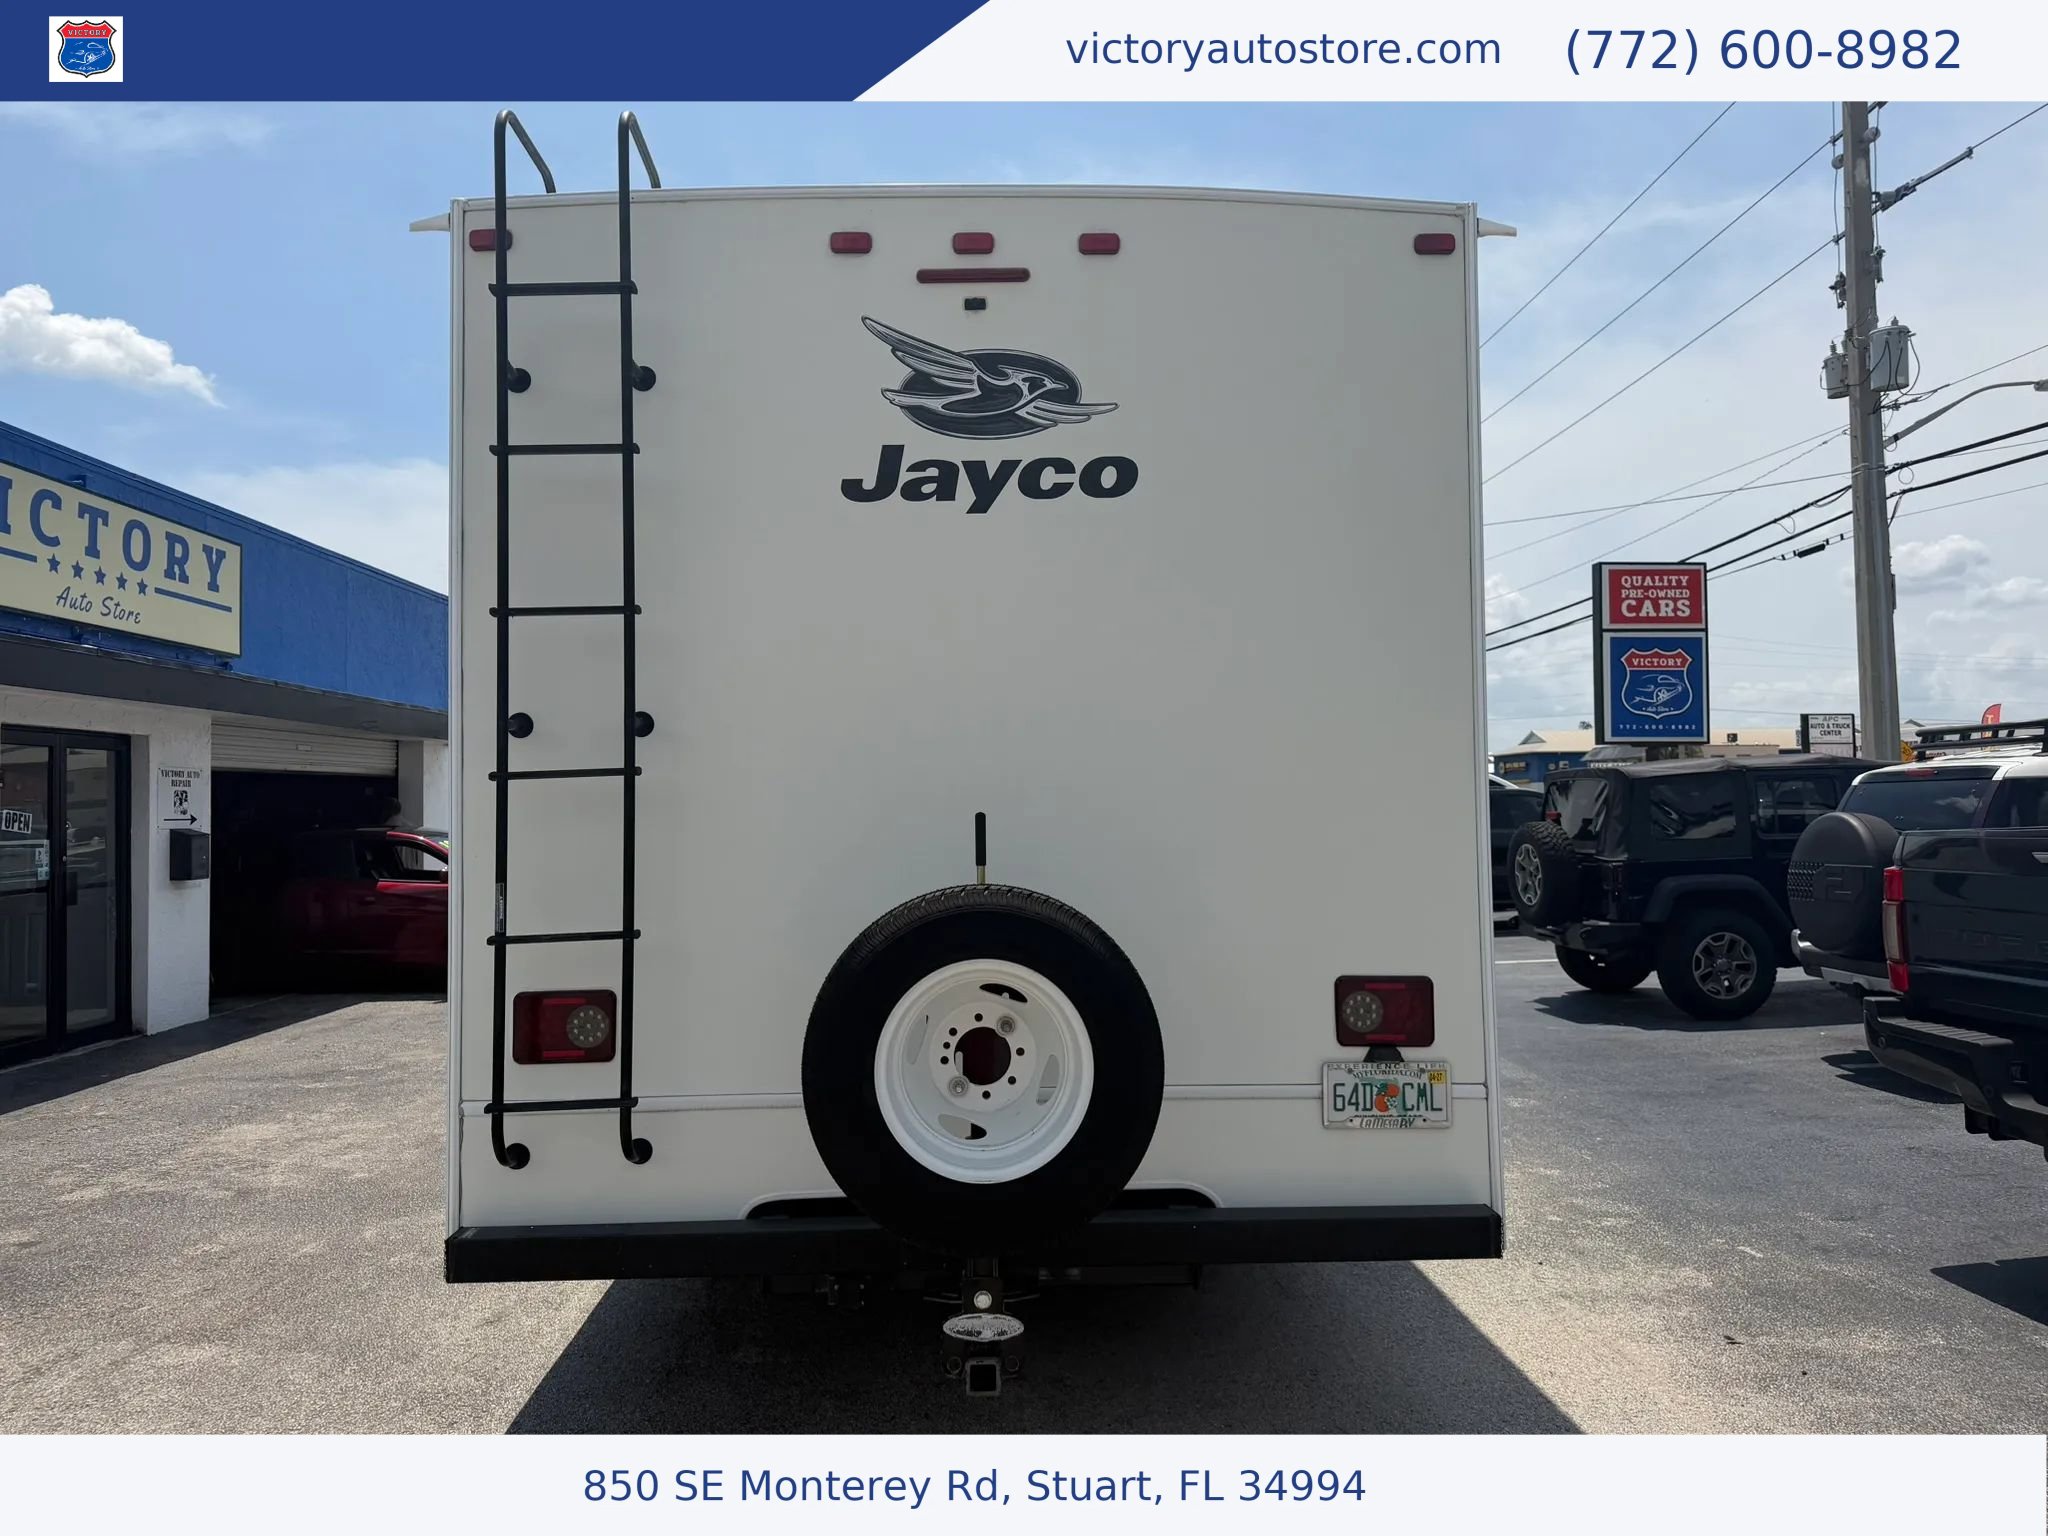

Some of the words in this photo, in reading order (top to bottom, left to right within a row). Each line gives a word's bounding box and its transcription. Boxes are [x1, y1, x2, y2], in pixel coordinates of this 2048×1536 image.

[841, 444, 1139, 514] Jayco
[1620, 575, 1689, 588] QUALITY
[1620, 589, 1690, 599] PRE-OWNED
[56, 585, 93, 613] Auto
[100, 596, 141, 625] Store
[1621, 600, 1691, 617] CARS
[1632, 657, 1682, 667] VICTORY
[161, 769, 185, 779] VICTORY
[186, 770, 201, 779] AUTO
[171, 779, 192, 788] REPAIR
[4, 811, 31, 833] OPEN
[1333, 1083, 1373, 1112] 64D
[1402, 1083, 1443, 1112] CML
